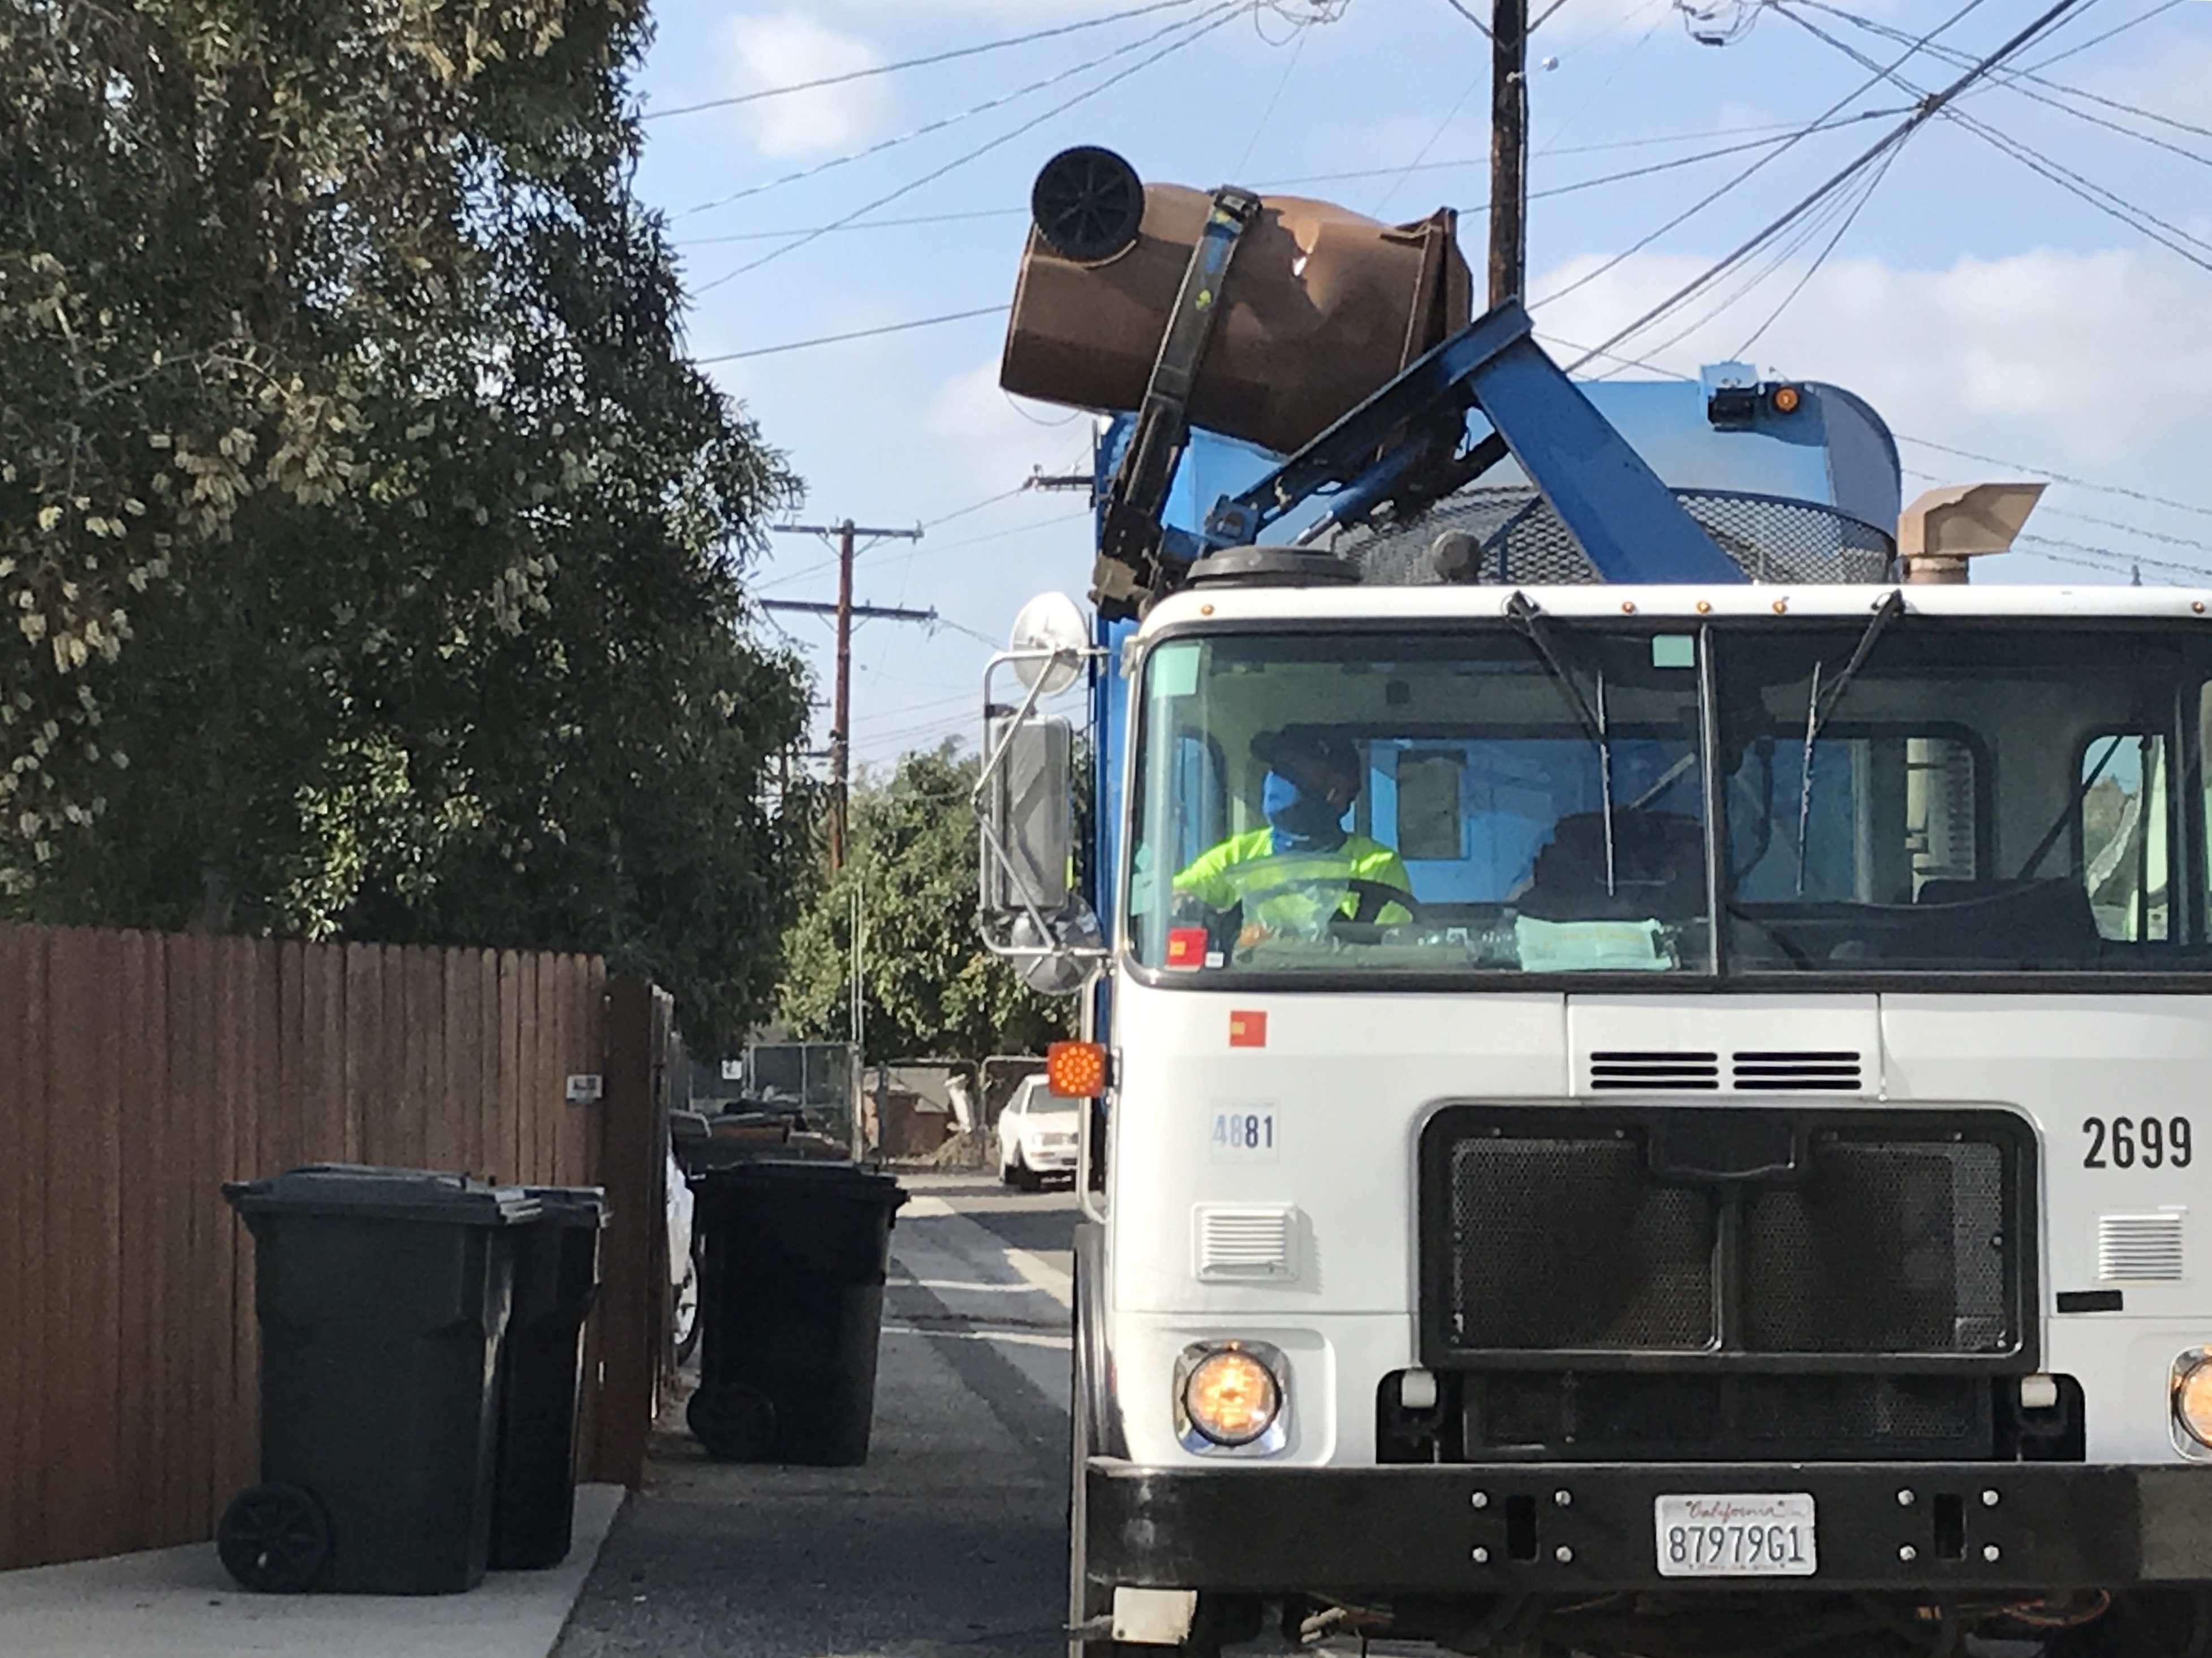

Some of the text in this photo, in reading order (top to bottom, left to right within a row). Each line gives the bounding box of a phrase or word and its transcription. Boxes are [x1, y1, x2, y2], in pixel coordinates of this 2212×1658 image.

[1212, 1114, 1272, 1148] 4881
[2082, 1116, 2192, 1169] 2699
[1688, 1500, 1782, 1523] California
[1669, 1526, 1804, 1563] 87979G1
